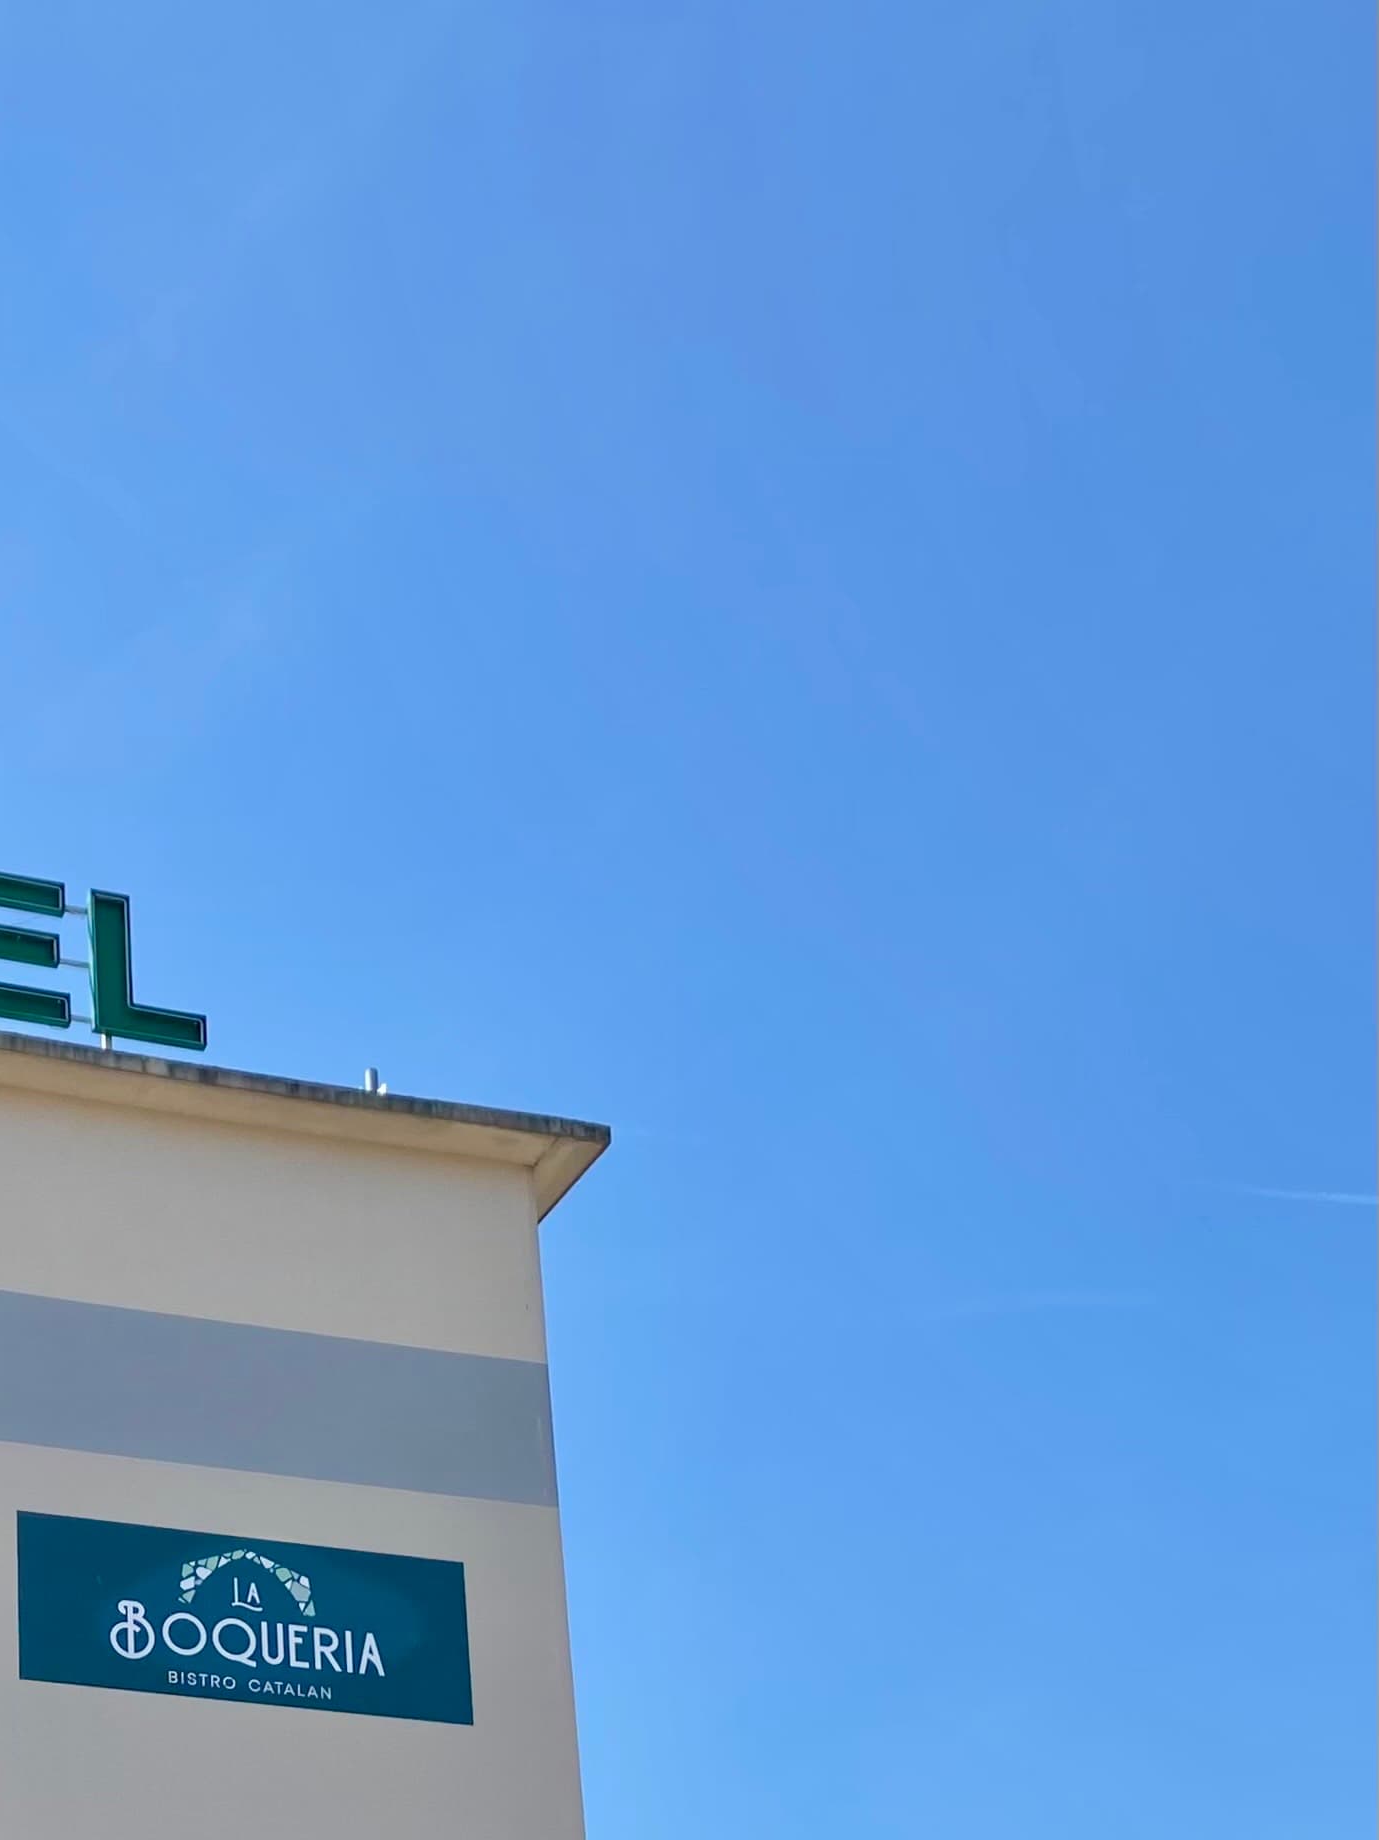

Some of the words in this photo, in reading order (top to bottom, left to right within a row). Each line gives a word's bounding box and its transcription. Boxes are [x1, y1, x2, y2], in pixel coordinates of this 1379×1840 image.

[231, 1577, 263, 1612] LA
[109, 1599, 386, 1677] BOQUERIA
[168, 1670, 236, 1690] BISTRO
[248, 1679, 332, 1700] CATALAN
